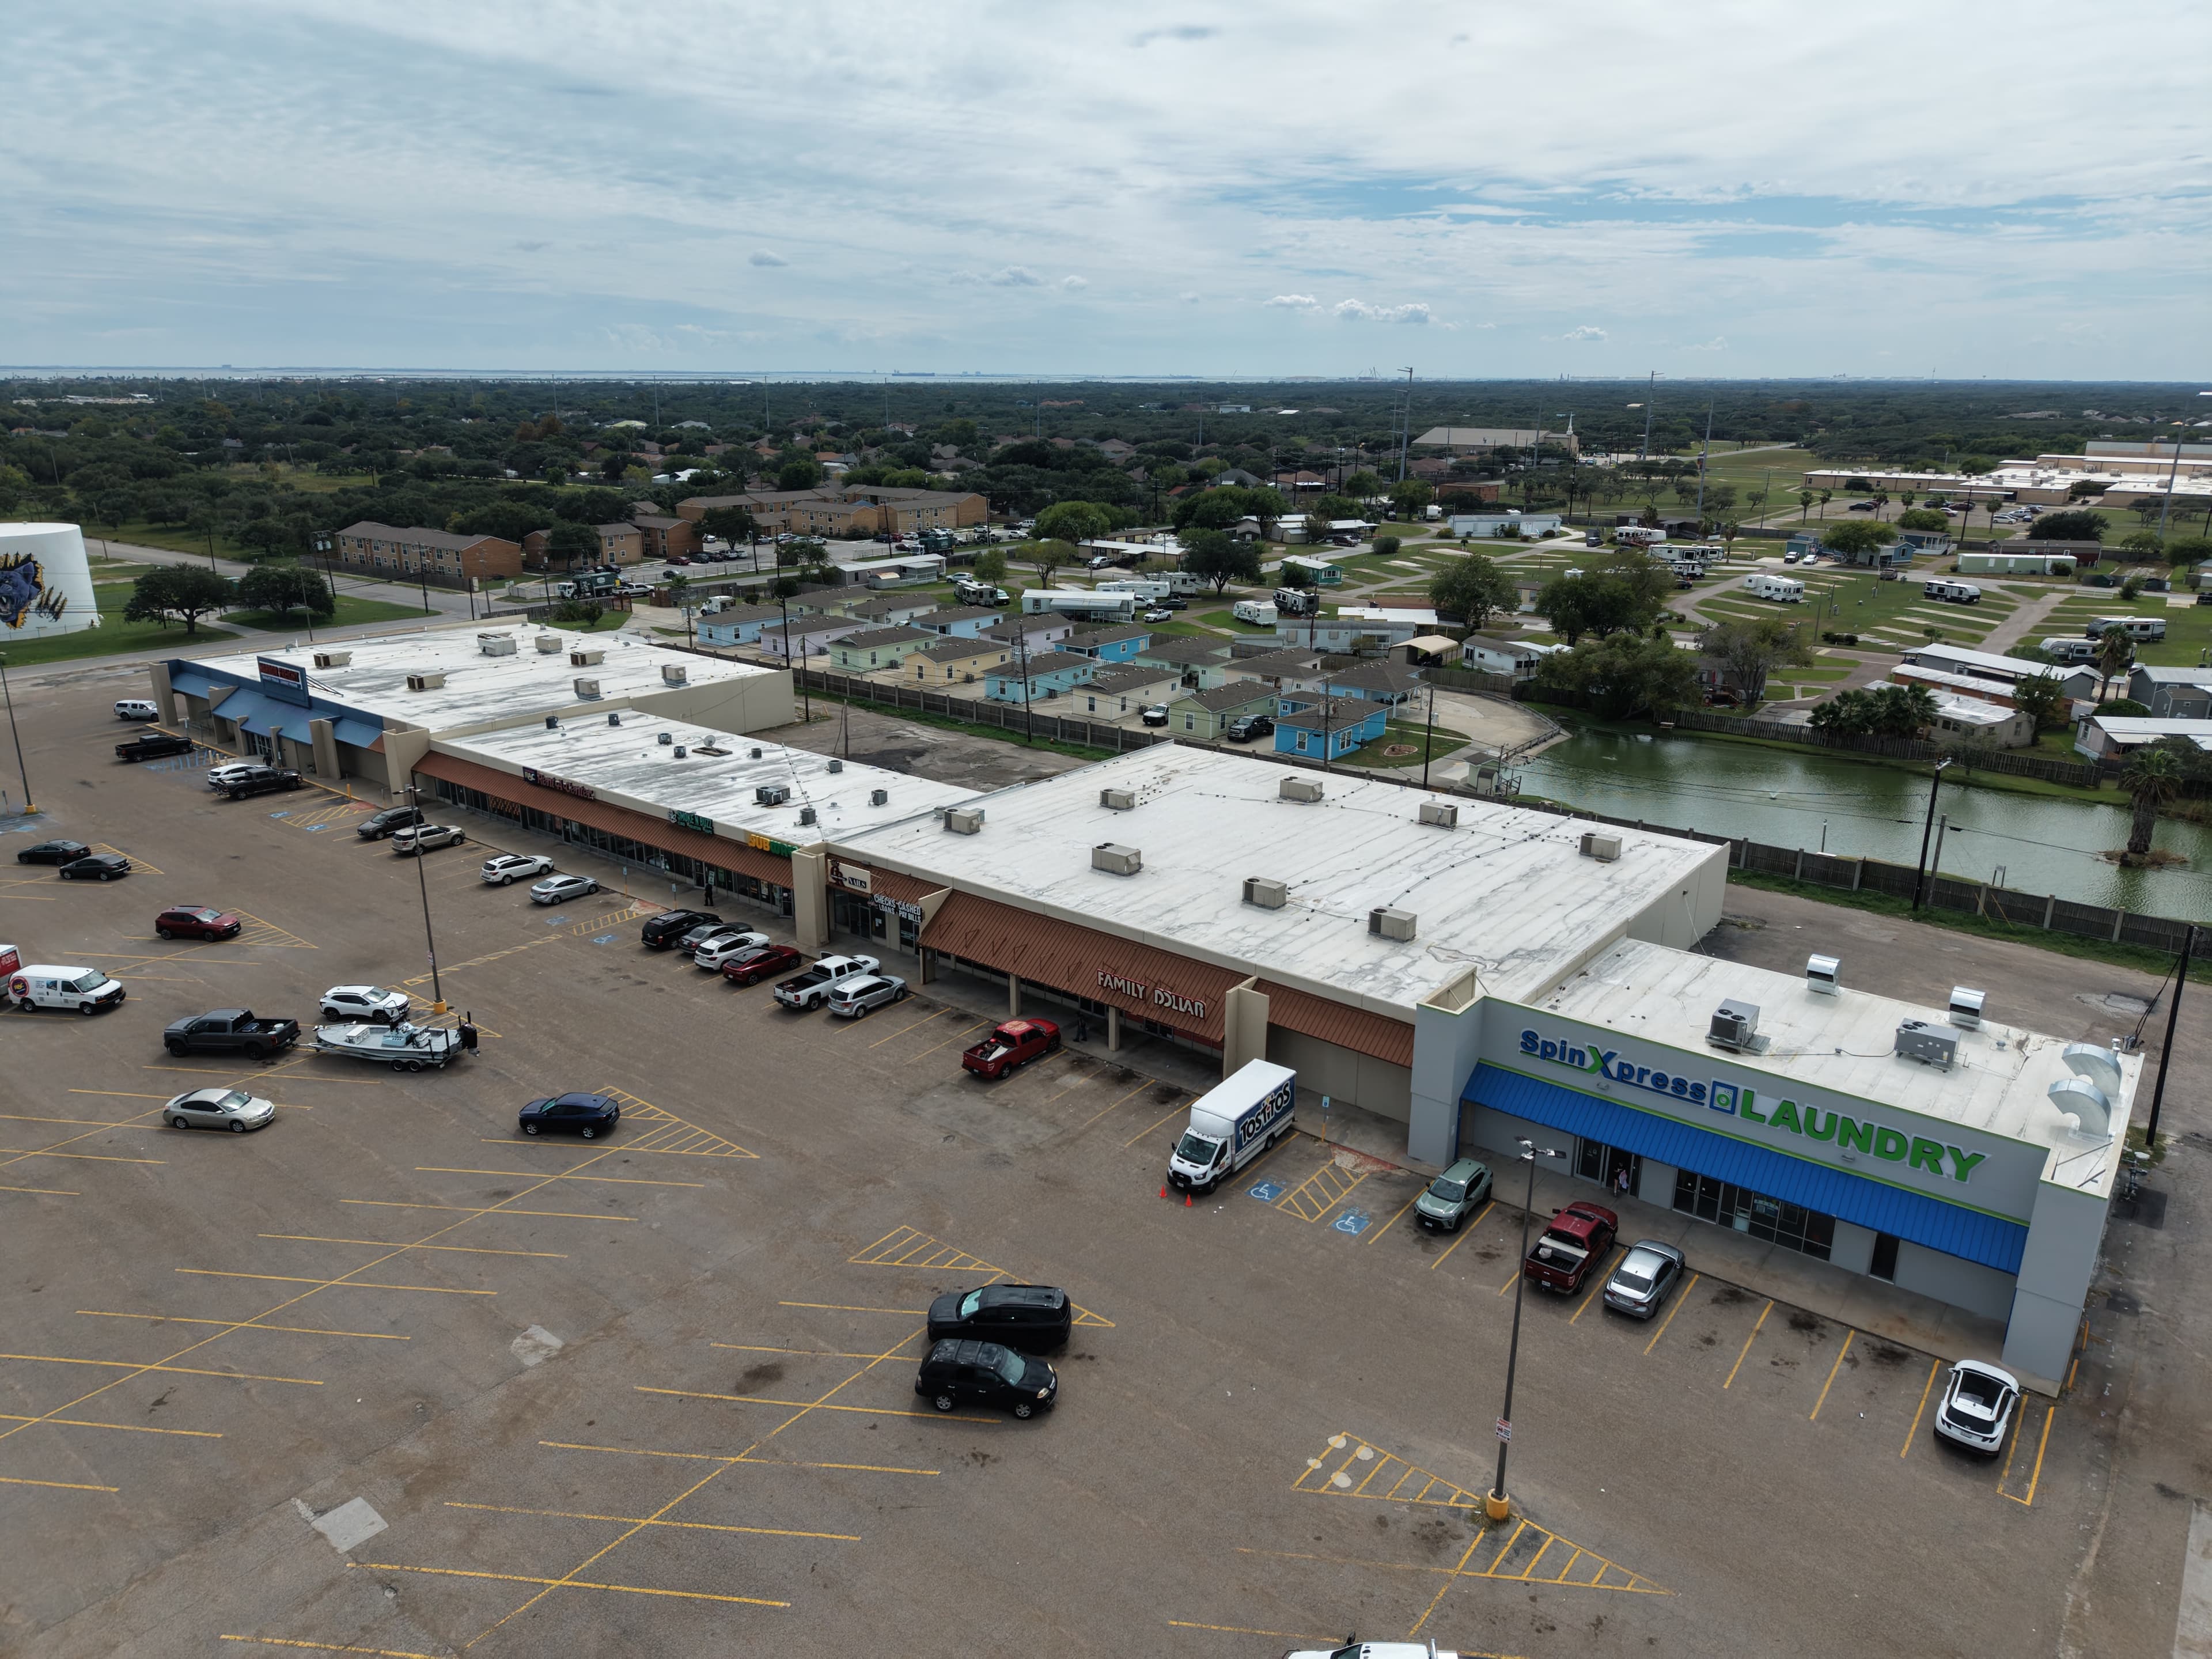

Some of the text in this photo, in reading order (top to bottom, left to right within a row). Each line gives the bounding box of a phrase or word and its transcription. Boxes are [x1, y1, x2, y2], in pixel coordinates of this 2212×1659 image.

[849, 877, 867, 889] NAILS
[874, 895, 896, 908] CHECKS
[898, 902, 921, 916] CASHED
[879, 904, 921, 923] LOANS PAY BILLS
[1097, 971, 1205, 1018] FAMILY DOLLAR
[1520, 1030, 1706, 1100] SpinXpress
[1740, 1089, 1986, 1183] LAUNDRY
